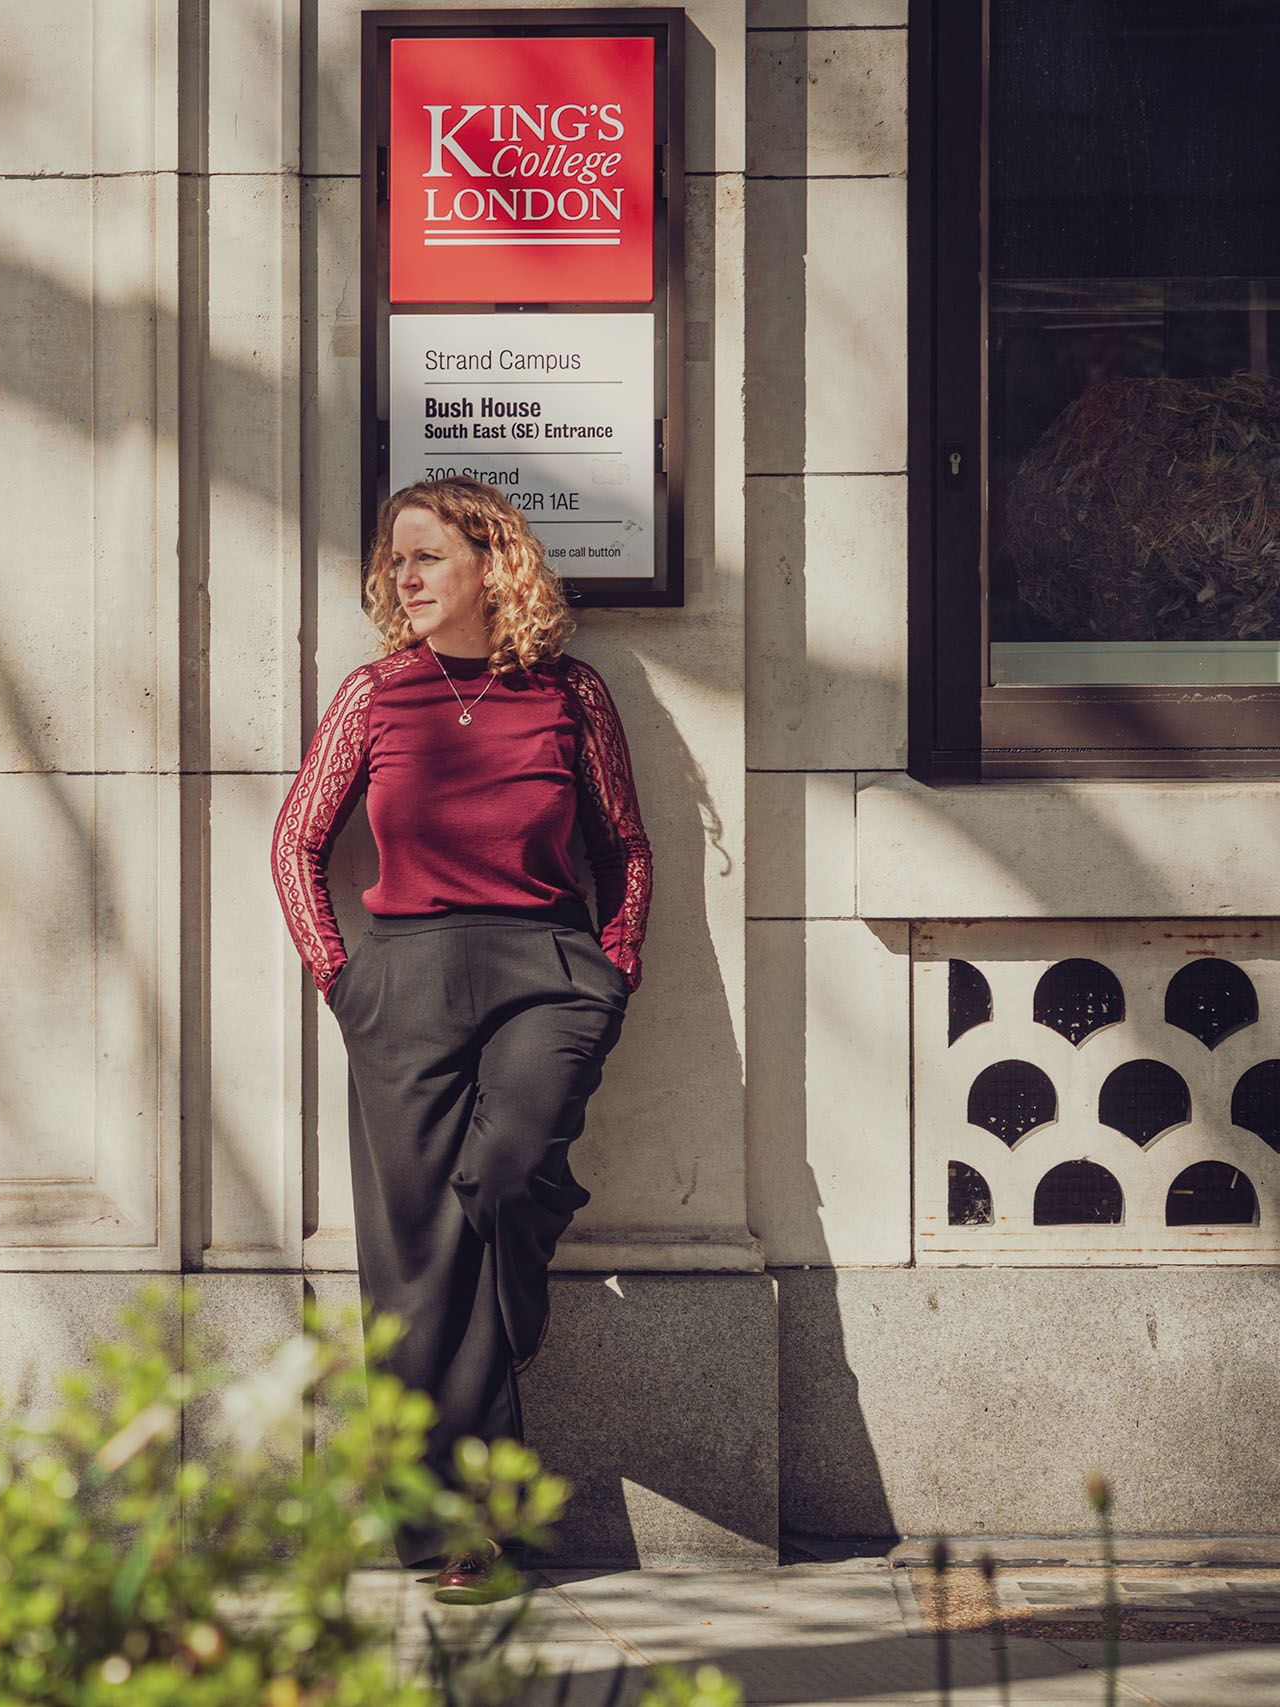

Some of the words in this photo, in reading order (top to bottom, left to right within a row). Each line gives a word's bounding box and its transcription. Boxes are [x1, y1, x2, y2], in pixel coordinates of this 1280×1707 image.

[422, 103, 625, 178] KING'S
[491, 144, 623, 185] College
[423, 187, 625, 222] LONDON
[424, 349, 493, 371] Strand
[498, 349, 582, 374] Campus
[424, 397, 474, 419] Bush
[480, 397, 542, 419] House
[424, 423, 468, 440] South
[472, 423, 507, 440] East
[511, 422, 540, 440] (SE)
[544, 423, 614, 439] Entrance
[505, 492, 545, 511] C2R
[549, 493, 580, 511] 1AE
[548, 548, 567, 558] use
[568, 546, 586, 558] call
[588, 546, 621, 558] button
